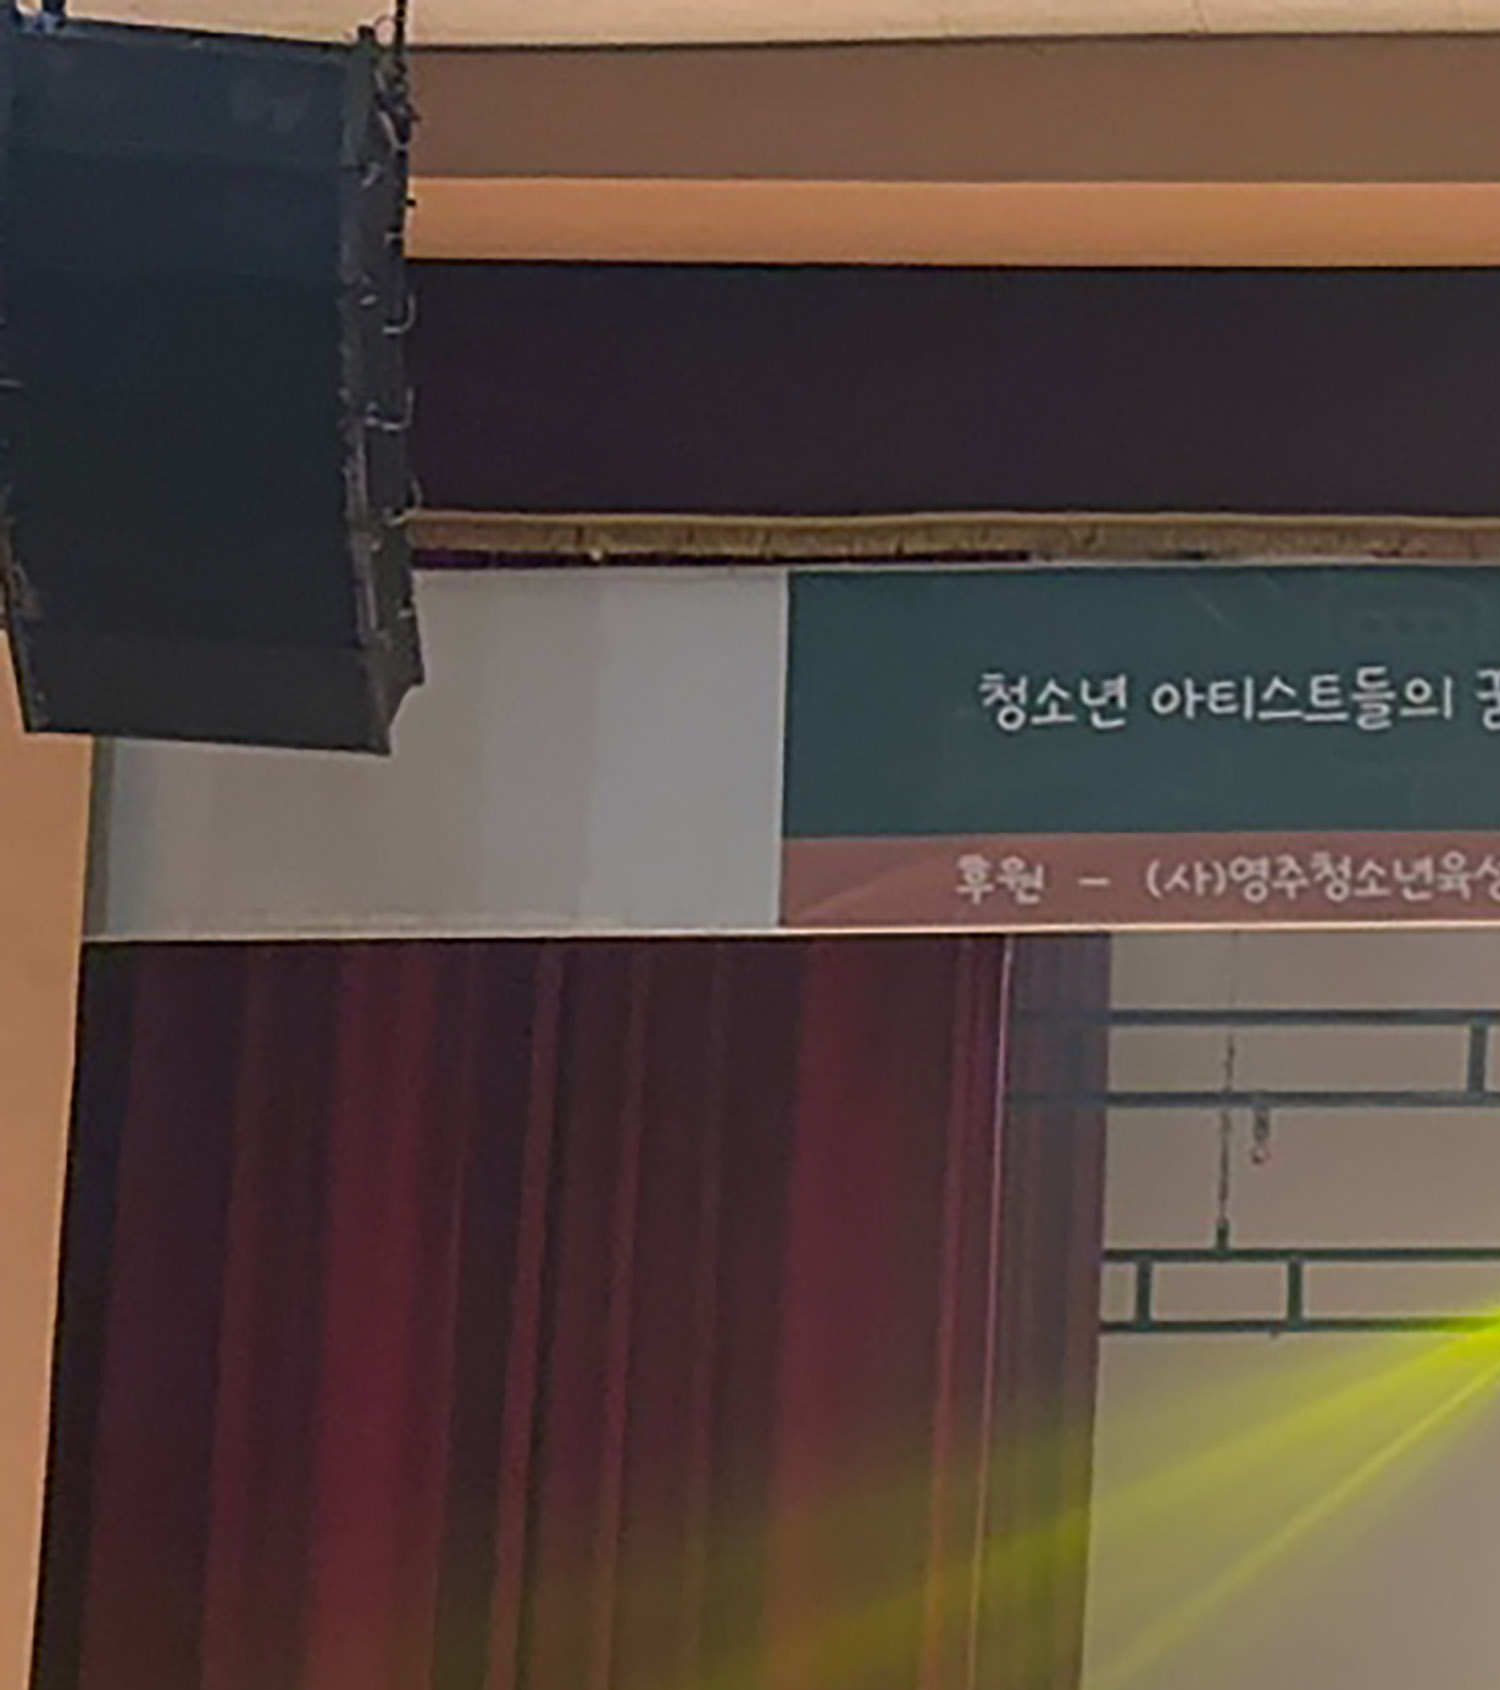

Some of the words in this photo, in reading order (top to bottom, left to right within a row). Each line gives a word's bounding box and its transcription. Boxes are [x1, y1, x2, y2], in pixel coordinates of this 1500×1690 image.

[979, 670, 1128, 732] 청소년
[1150, 664, 1454, 731] 아티스트들의
[955, 853, 1045, 905] 후원
